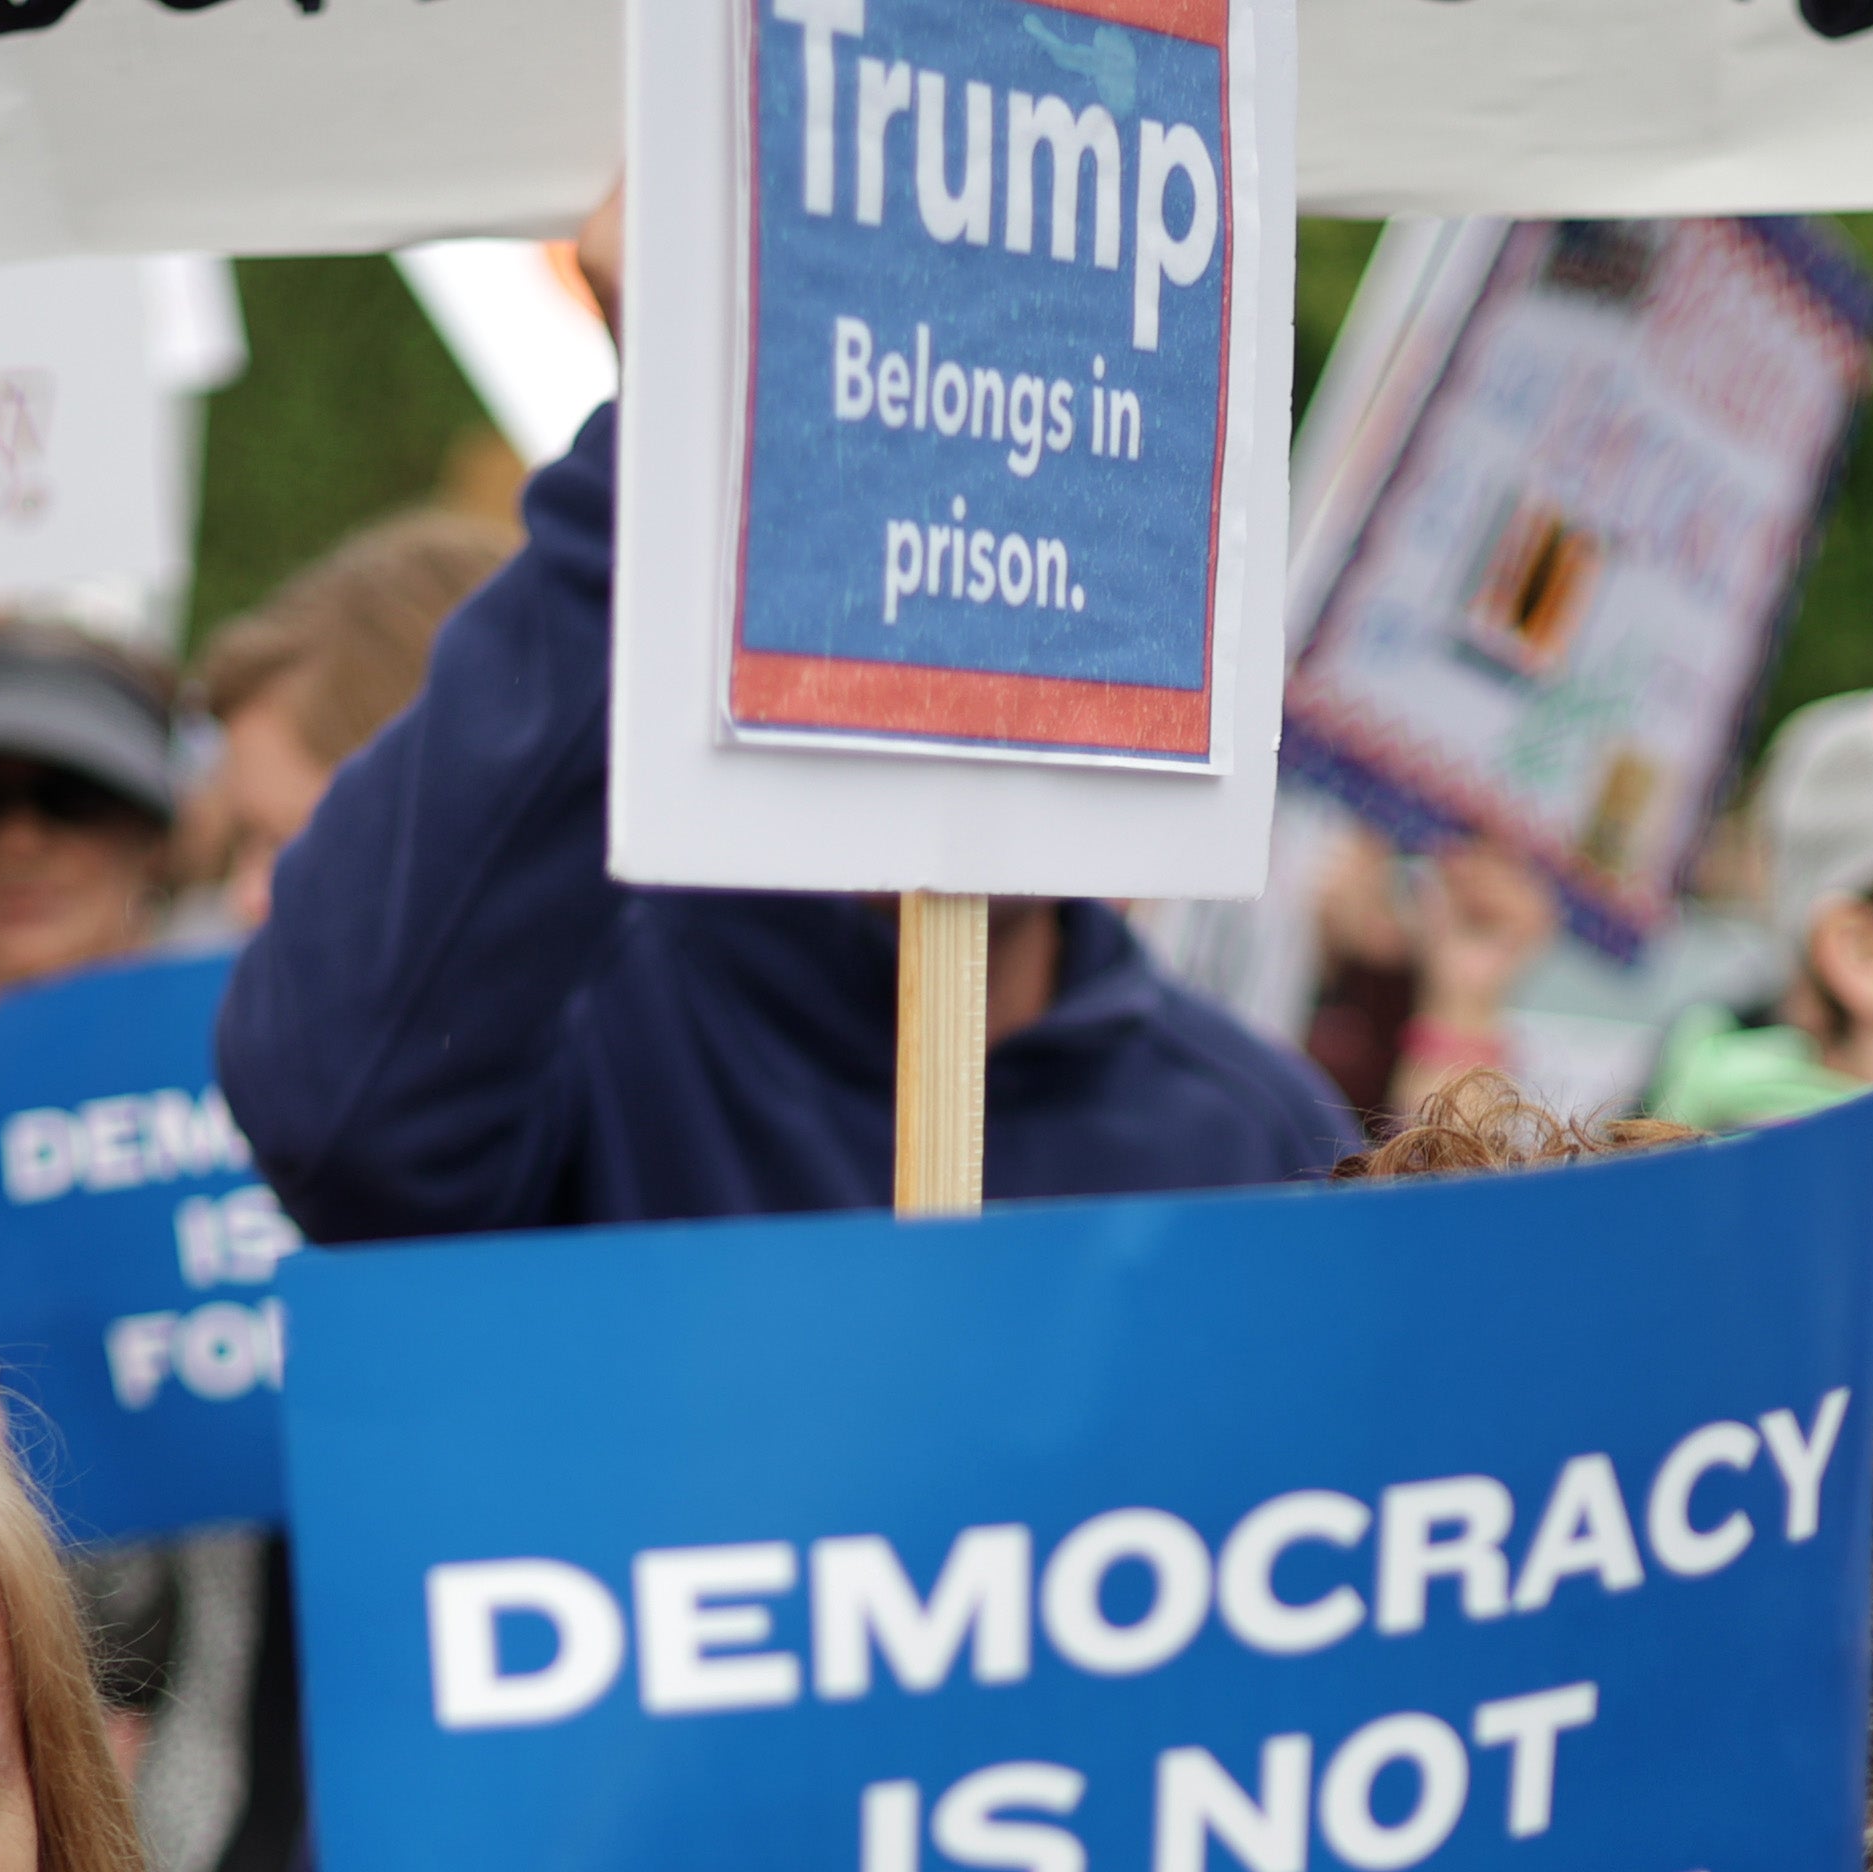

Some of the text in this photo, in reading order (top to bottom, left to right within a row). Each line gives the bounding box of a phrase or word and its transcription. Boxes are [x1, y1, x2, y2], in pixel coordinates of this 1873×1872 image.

[773, 0, 1218, 352] Trump
[834, 315, 1142, 477] Belongs in
[884, 494, 1085, 626] prison.
[174, 1184, 305, 1290] IS
[426, 1388, 1850, 1732] DEMOCRACY
